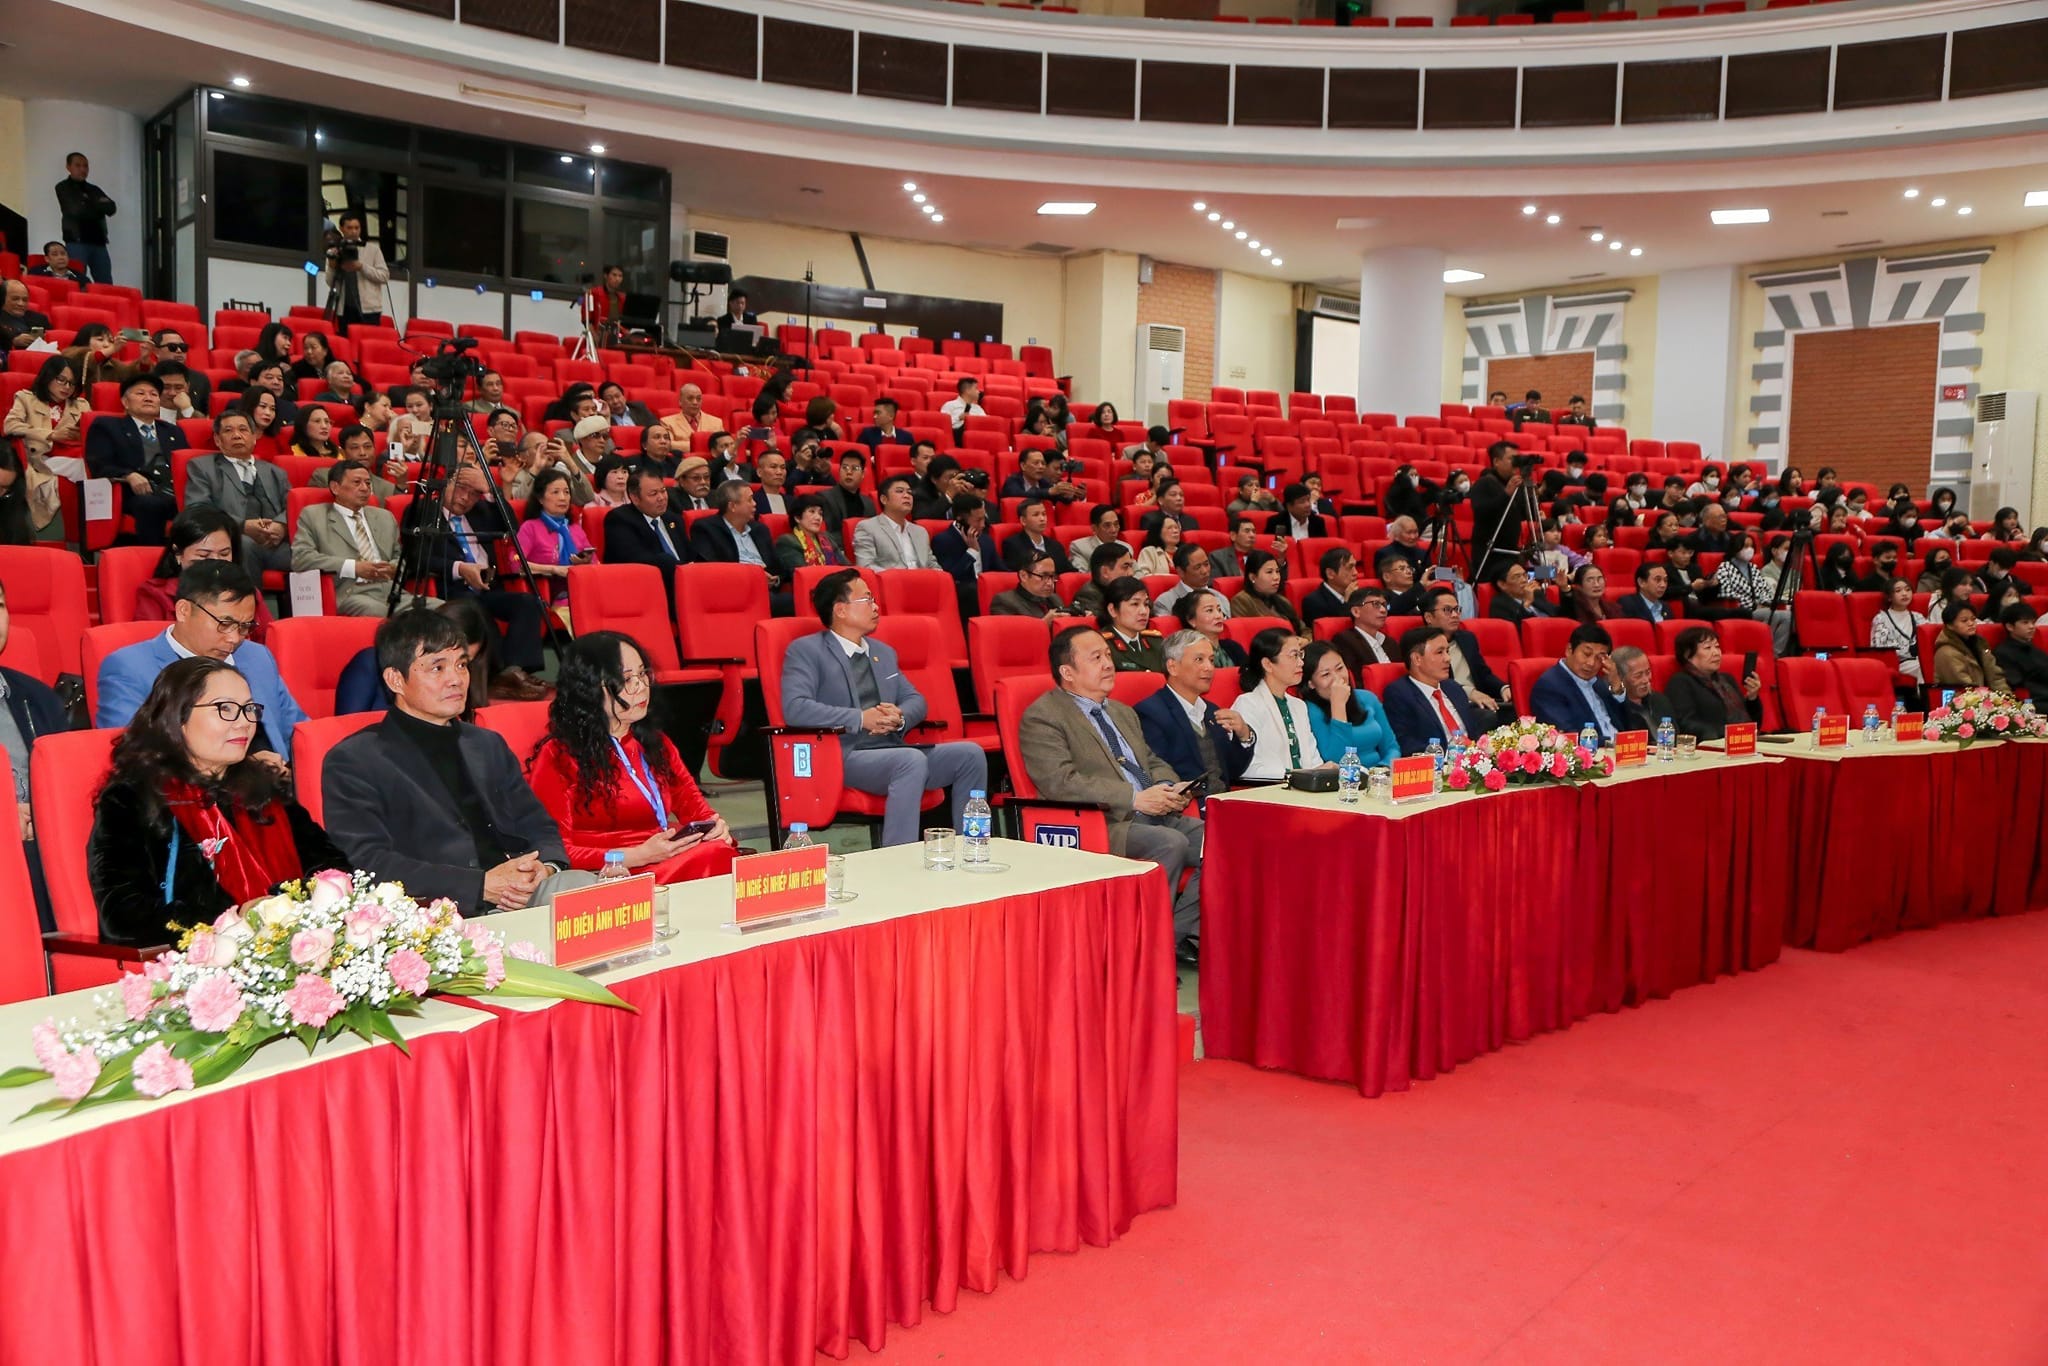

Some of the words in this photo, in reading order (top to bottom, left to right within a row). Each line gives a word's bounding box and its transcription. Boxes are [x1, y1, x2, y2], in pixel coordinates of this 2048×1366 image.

[1039, 832, 1077, 848] VIP
[801, 866, 813, 890] VIỆT
[813, 867, 826, 886] NAM
[556, 915, 571, 944] HỘI
[573, 911, 594, 939] ĐIỆN
[595, 905, 613, 932] ẢNH
[614, 902, 632, 929] VIỆT
[632, 900, 651, 922] NAM
